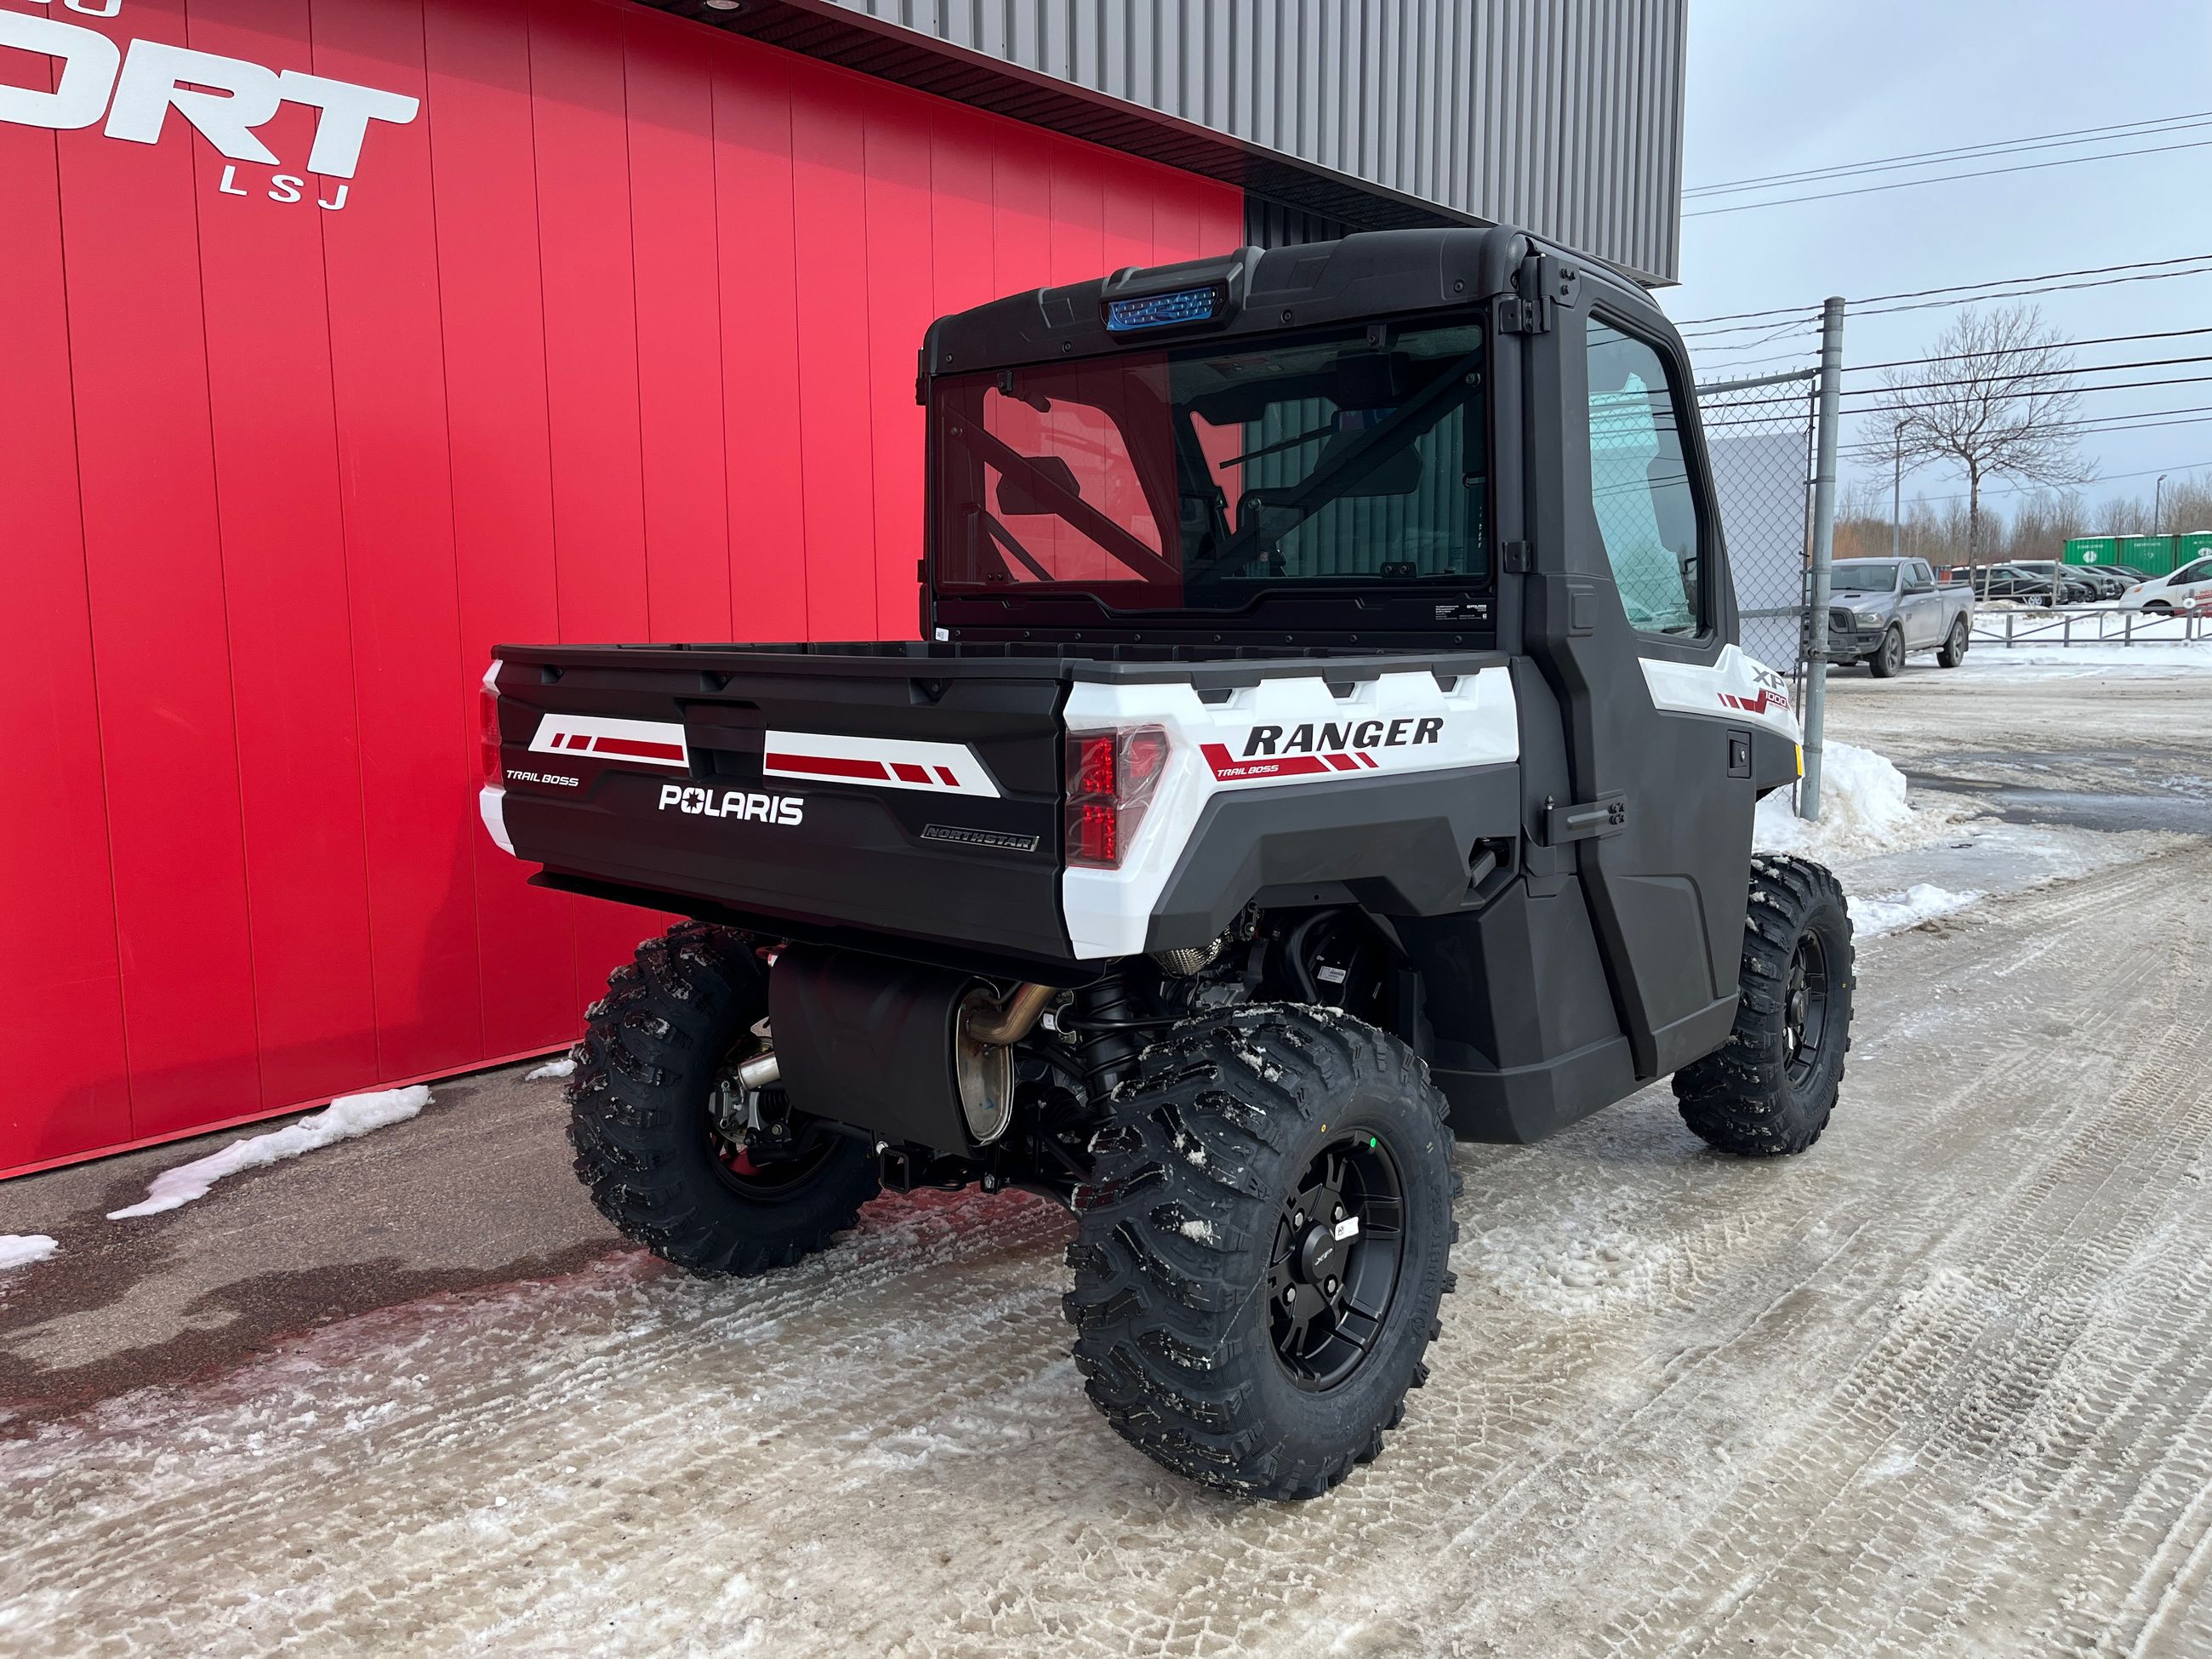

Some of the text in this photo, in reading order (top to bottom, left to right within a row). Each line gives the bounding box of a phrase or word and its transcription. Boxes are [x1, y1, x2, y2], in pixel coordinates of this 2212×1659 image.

[1753, 667, 1784, 689] XP
[1765, 691, 1786, 706] 1000
[1242, 717, 1444, 756] RANGER
[506, 769, 579, 787] TRAIL BOSS
[1217, 765, 1279, 778] TRAIL BOSS
[658, 784, 804, 826] POLARIS
[926, 827, 1032, 848] NORTHSTAR
